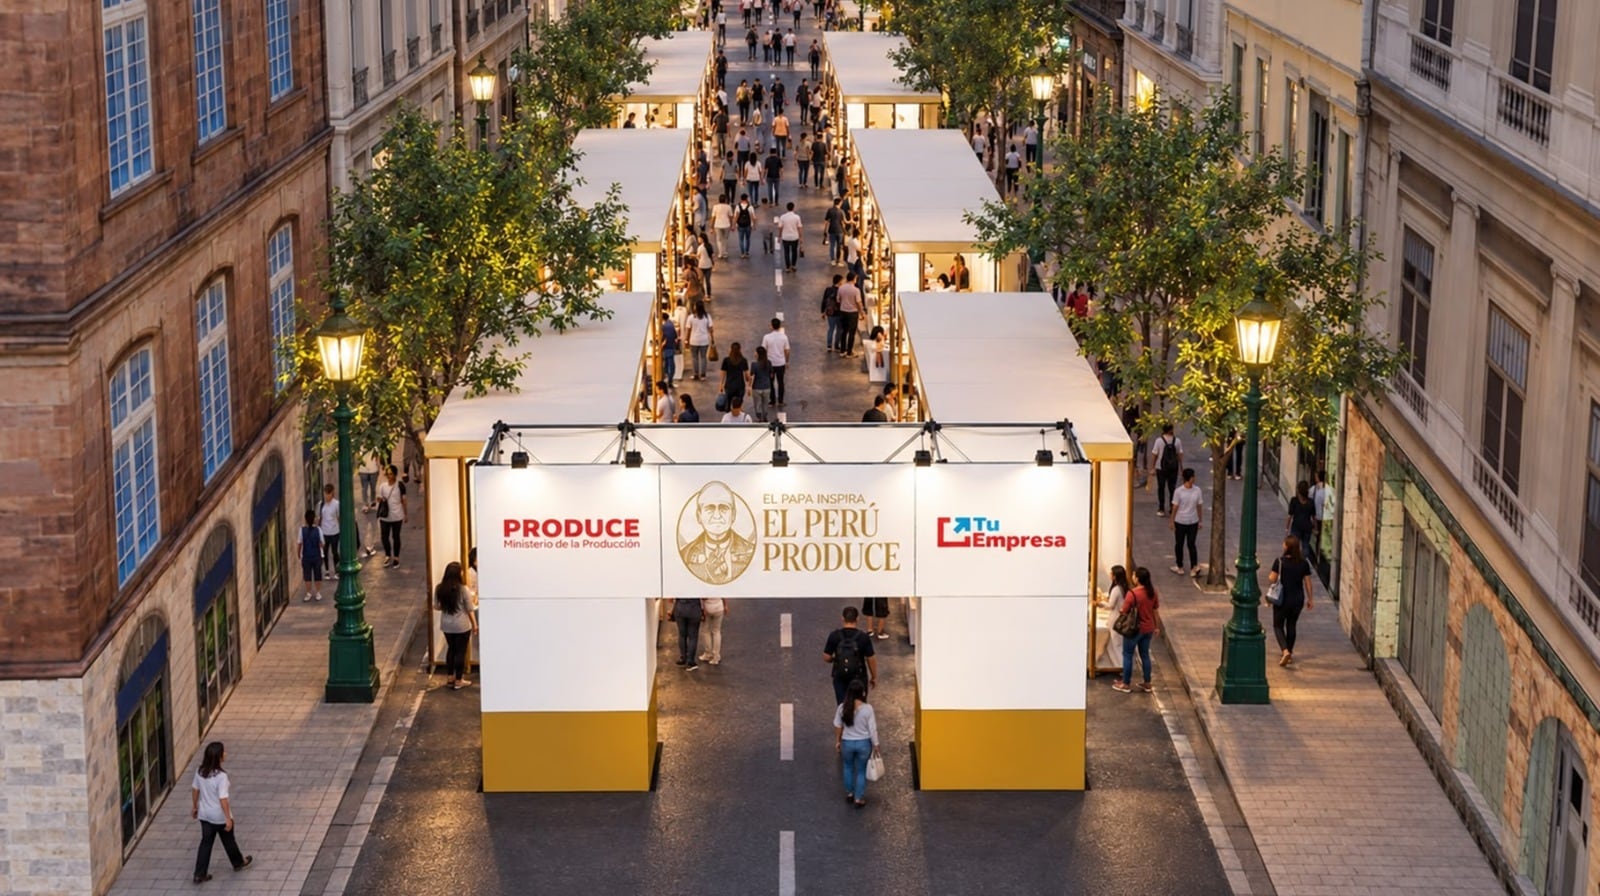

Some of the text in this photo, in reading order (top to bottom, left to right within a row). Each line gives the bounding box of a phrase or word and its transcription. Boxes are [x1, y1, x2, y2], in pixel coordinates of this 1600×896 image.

[763, 494, 866, 505] EL PAPA INSPIRA
[503, 518, 640, 538] PRODUCE
[763, 502, 879, 538] EL PERÚ
[973, 517, 1000, 532] Tu
[503, 539, 641, 549] Ministerio de la Producción
[973, 532, 1066, 552] Empresa
[763, 543, 901, 572] PRODUCE
